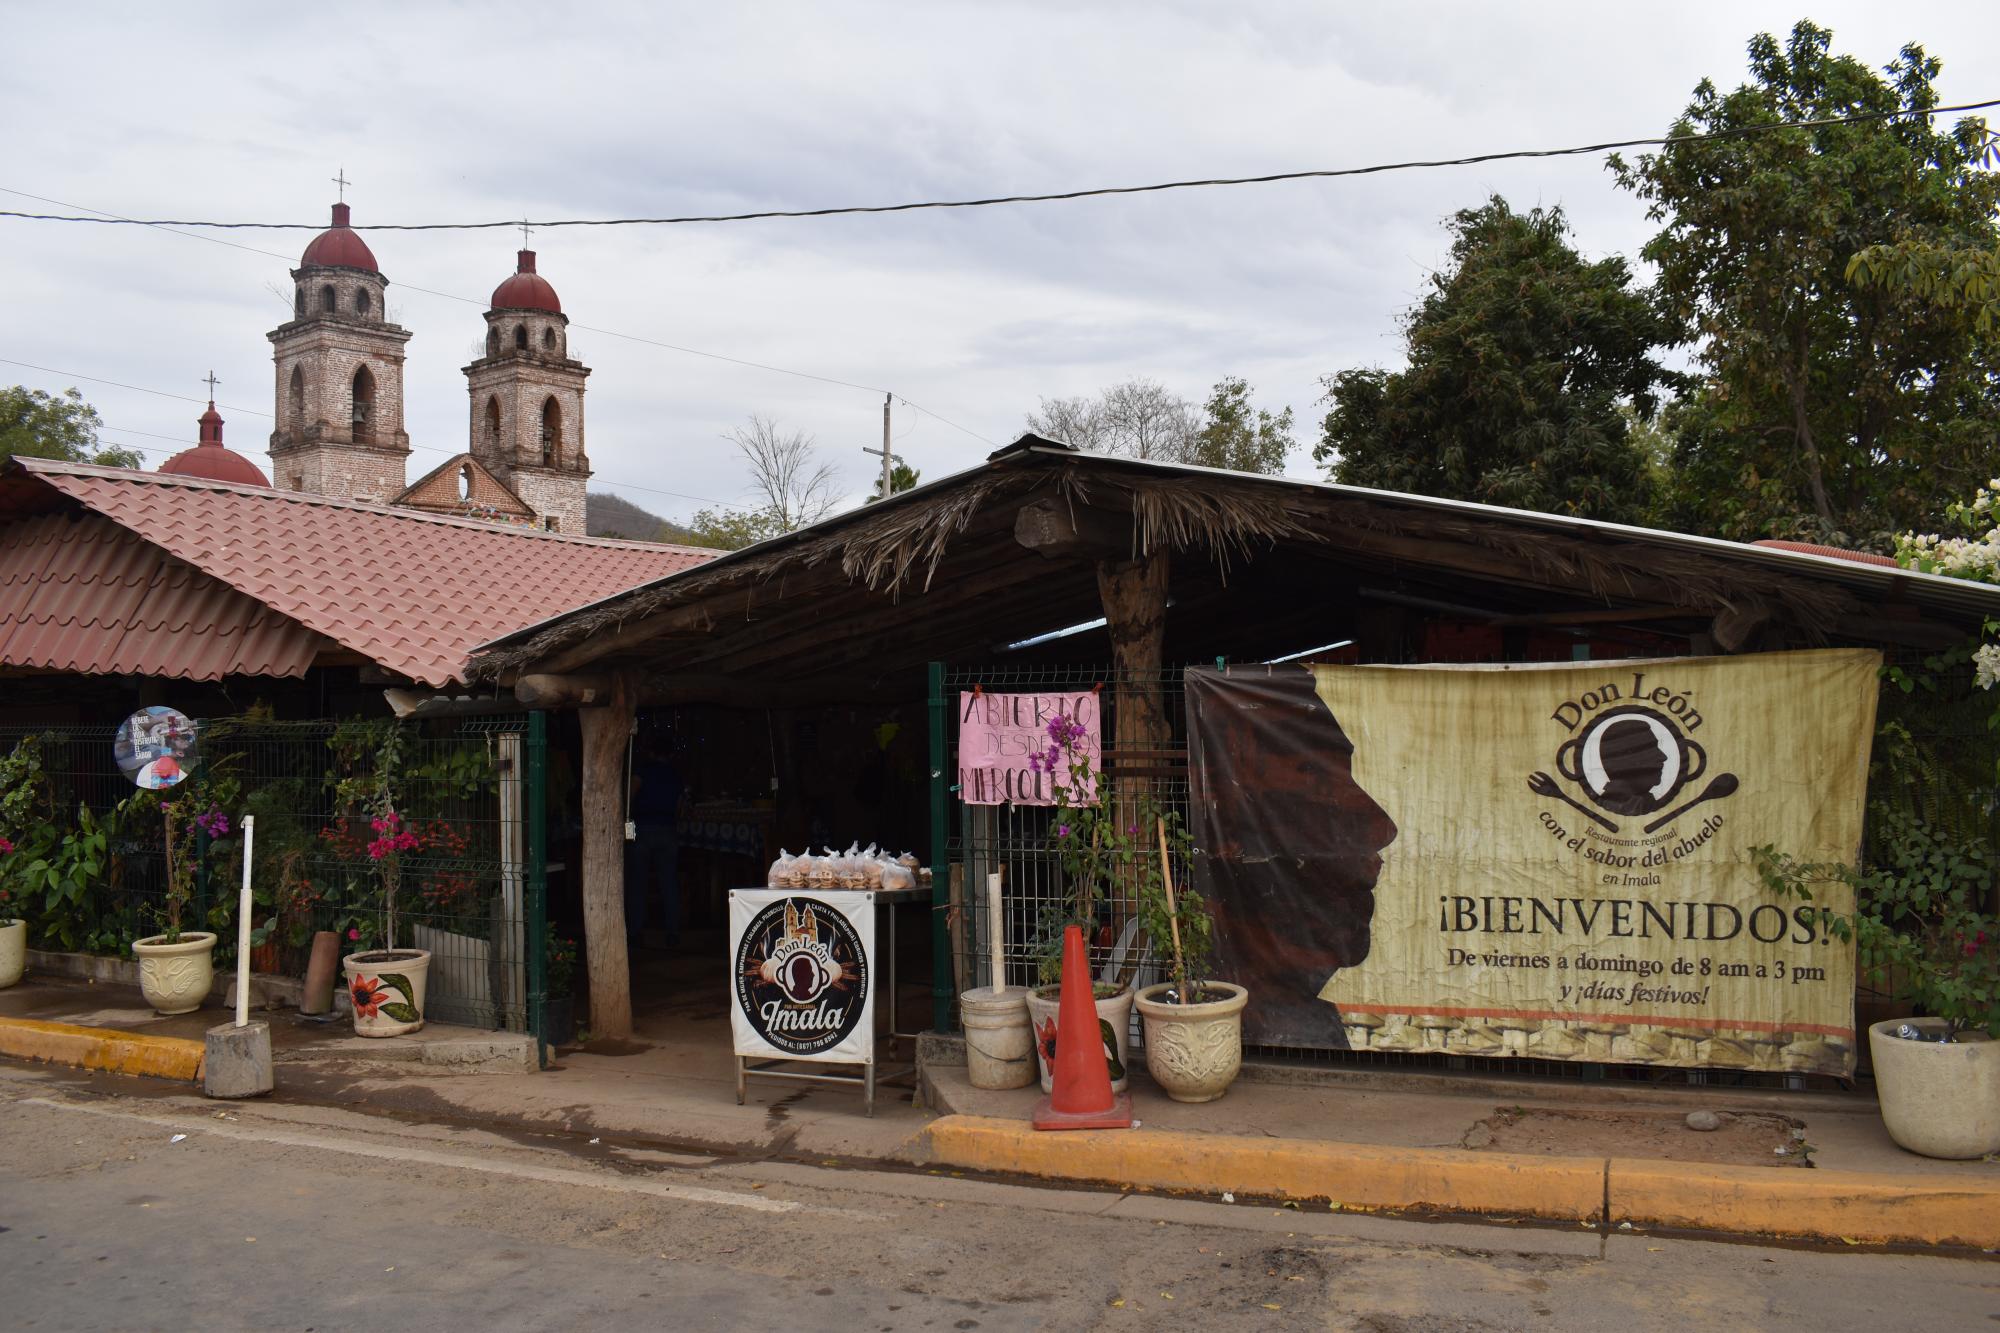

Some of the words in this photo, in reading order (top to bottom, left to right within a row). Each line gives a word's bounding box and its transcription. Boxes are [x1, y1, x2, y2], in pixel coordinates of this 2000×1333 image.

[963, 694, 1093, 728] ABIERTO
[1550, 682, 1624, 733] Don
[1629, 672, 1704, 734] León
[984, 732, 1049, 759] DESDE
[1059, 732, 1100, 759] OS
[1539, 811, 1567, 841] con
[1567, 836, 1586, 854] el
[1584, 847, 1636, 868] sabor
[1641, 847, 1668, 867] del
[1673, 814, 1724, 860] abuelo
[1585, 826, 1638, 847] Restaurante
[1641, 827, 1679, 847] regional
[1602, 873, 1618, 885] en
[1623, 872, 1661, 887] Imala
[1440, 896, 1830, 945] ¡BIENVENIDOS!
[774, 940, 800, 962] Don
[803, 936, 828, 964] León
[1448, 948, 1476, 966] De
[1482, 949, 1550, 968] viernes
[1557, 957, 1568, 969] a
[1575, 952, 1664, 977] domingo
[1671, 956, 1694, 975] de
[1700, 957, 1712, 976] 8
[1718, 963, 1749, 976] am
[1755, 964, 1768, 978] a
[1774, 960, 1786, 979] 3
[1791, 966, 1826, 984] pm
[1557, 984, 1572, 1002] y
[1575, 981, 1625, 1004] ¡días
[1624, 982, 1710, 1005] festivos!
[760, 999, 845, 1032] Imala
